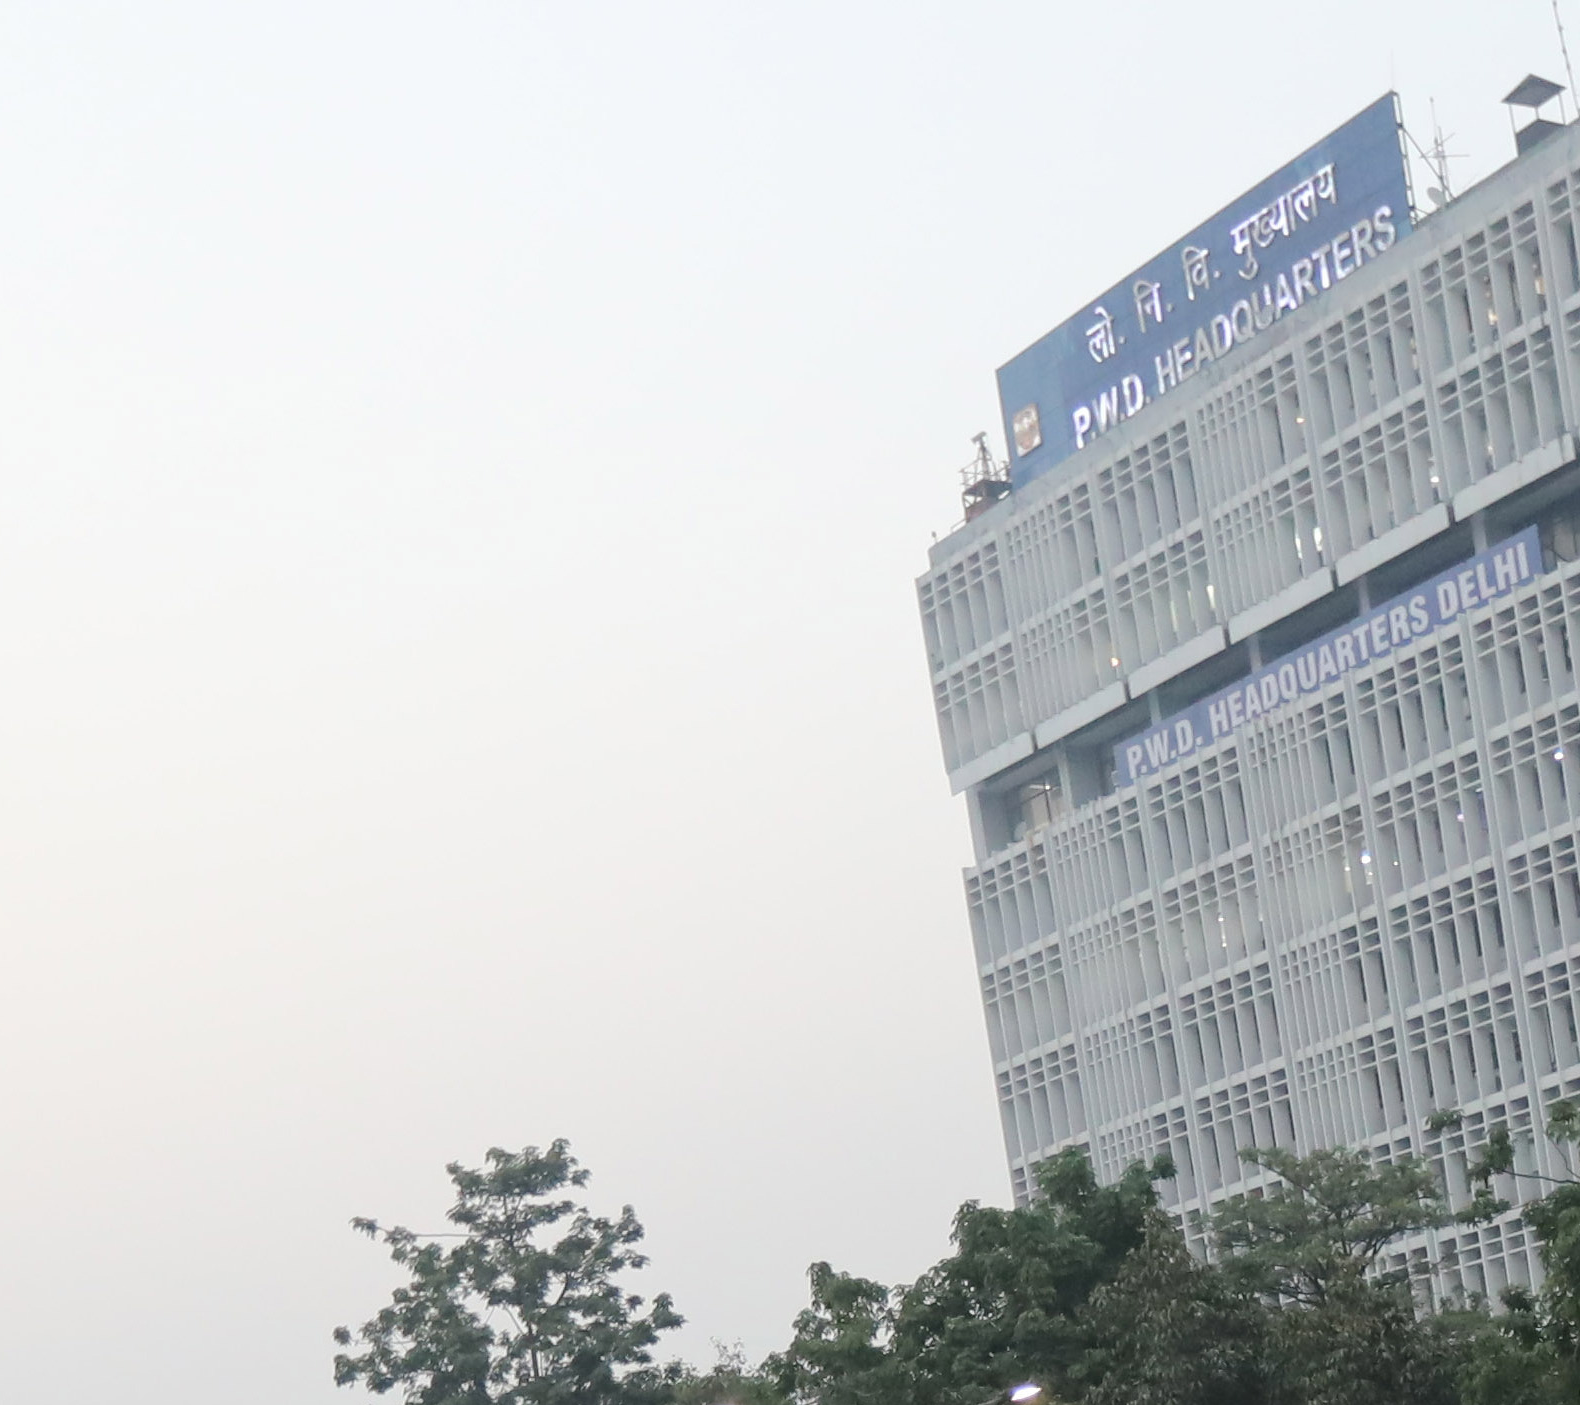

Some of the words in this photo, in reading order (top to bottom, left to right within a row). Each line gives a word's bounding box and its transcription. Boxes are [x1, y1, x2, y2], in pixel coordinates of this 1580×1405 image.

[1073, 373, 1151, 449] P.W.D.
[1154, 205, 1396, 395] HEADQUARTERS
[1085, 306, 1126, 363] लो.
[1133, 280, 1173, 333] नि.
[1181, 246, 1221, 300] वि.
[1230, 162, 1337, 281] मुख्यालय
[1126, 719, 1203, 780] P.W.D.
[1208, 594, 1429, 738] HEADQUARTERS
[1436, 542, 1531, 620] DELHI
